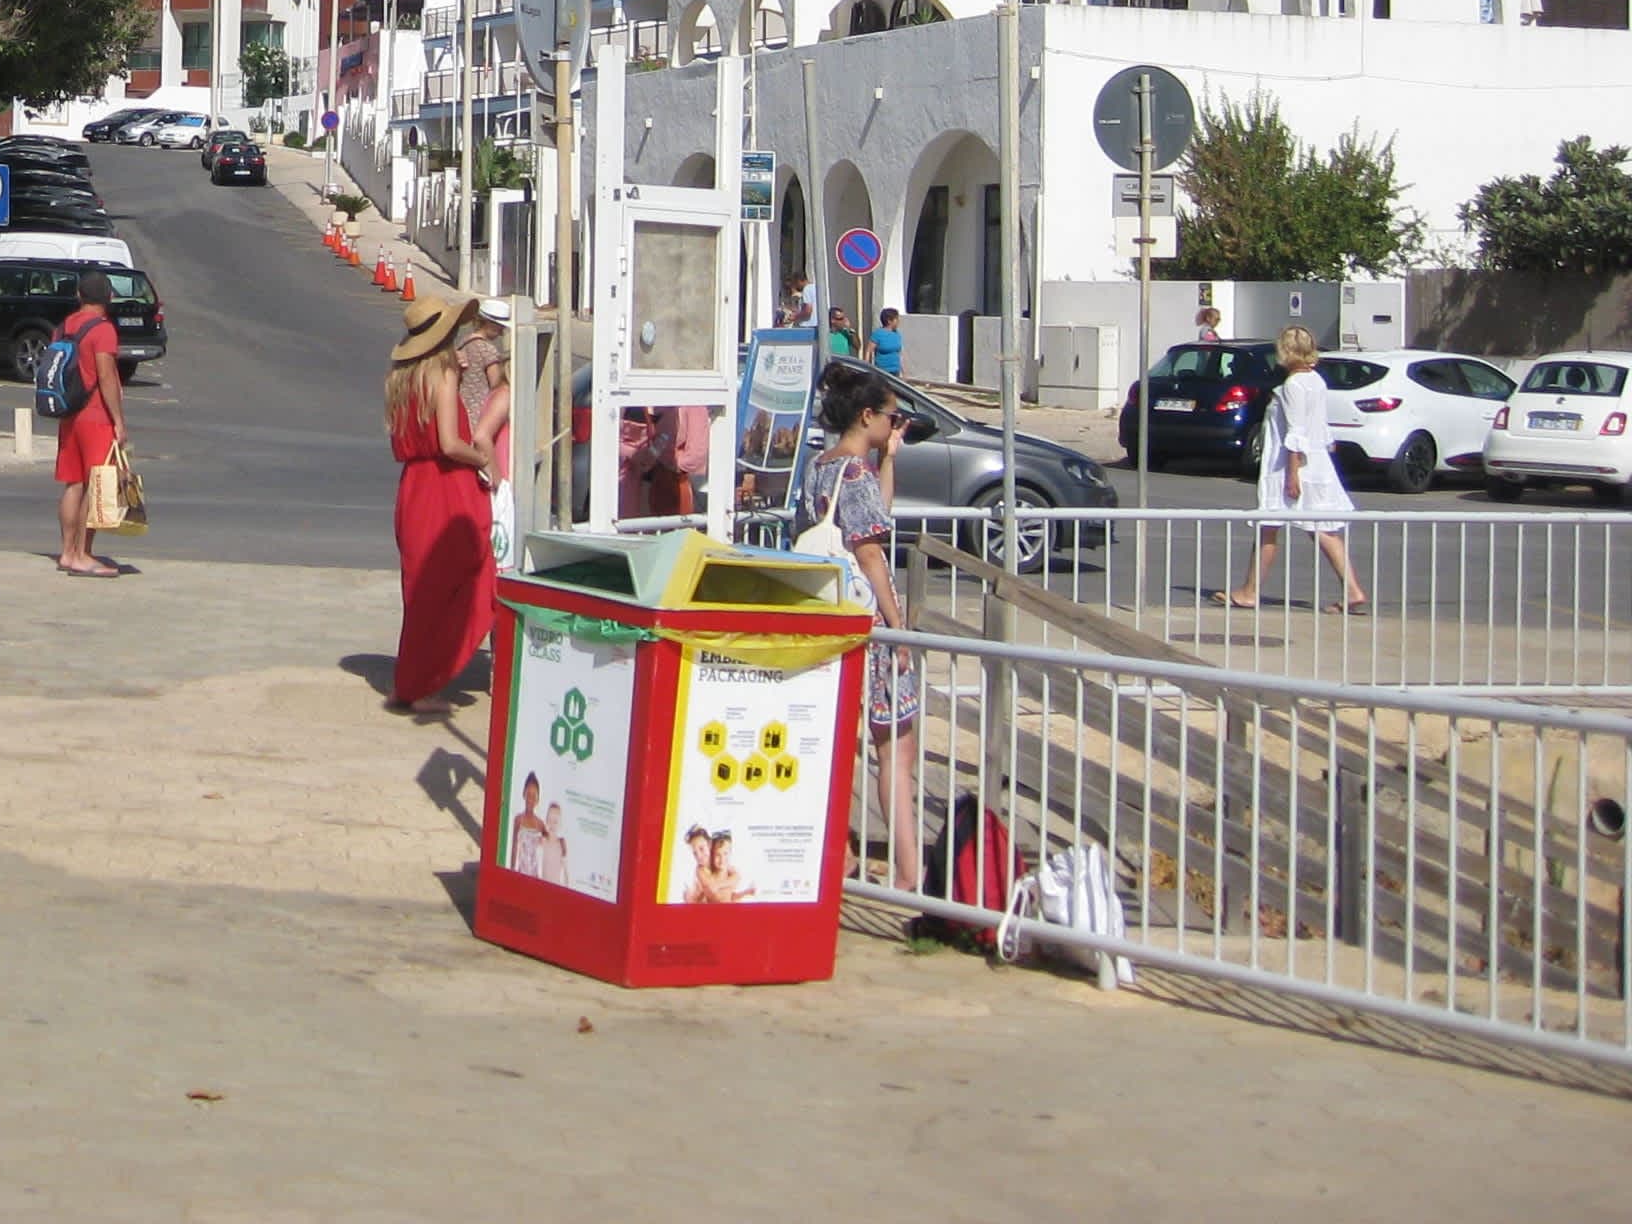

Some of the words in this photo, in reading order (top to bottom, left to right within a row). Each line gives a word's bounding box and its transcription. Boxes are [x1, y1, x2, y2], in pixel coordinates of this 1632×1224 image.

[528, 626, 563, 645] VIDRO
[528, 645, 561, 664] GLASS
[698, 667, 784, 684] PACKAGING
